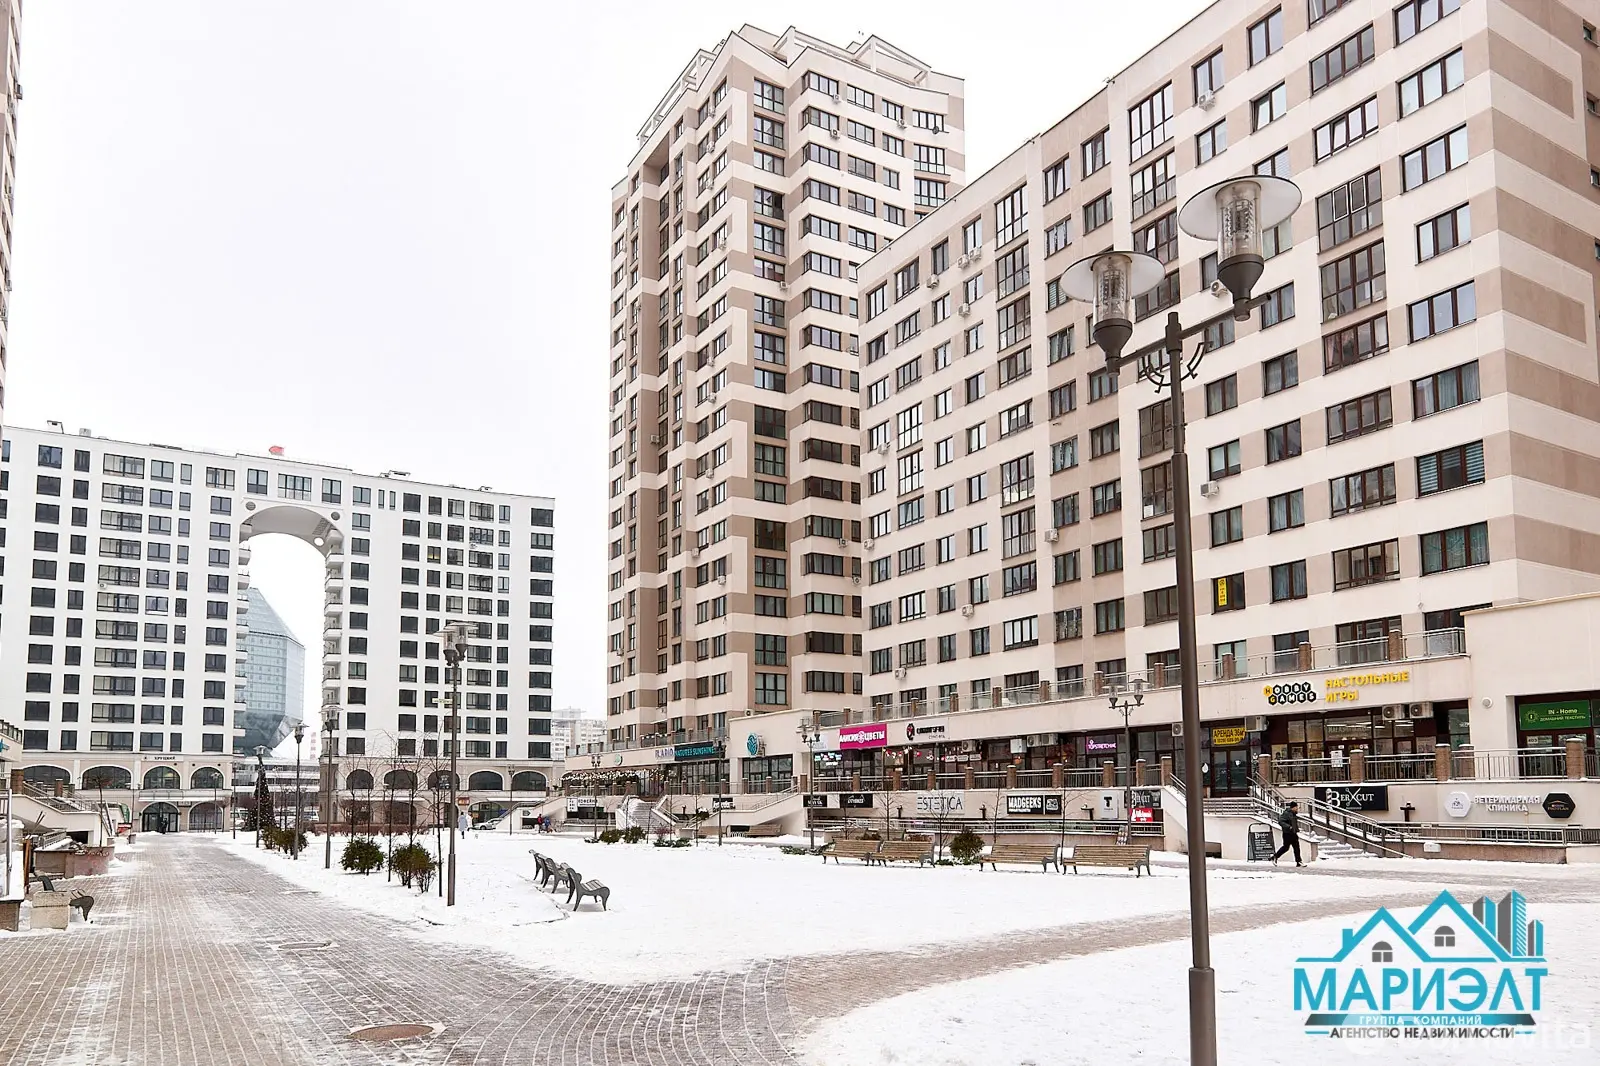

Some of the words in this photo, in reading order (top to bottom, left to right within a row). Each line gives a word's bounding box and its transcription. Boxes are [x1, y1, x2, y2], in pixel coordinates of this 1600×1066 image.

[1325, 670, 1410, 688] НАСТОЛЬНЫЕ
[1264, 682, 1312, 696] HOBBY
[1268, 691, 1317, 705] GAMES
[1325, 690, 1360, 703] ИГРЫ
[864, 731, 885, 741] ЦВЕТЫ
[1213, 729, 1233, 738] АРЕНДА
[1008, 796, 1042, 808] MADGEEKS
[1474, 795, 1541, 804] ВЕТЕРИНАРНАЯ
[1486, 804, 1529, 812] КЛИНИКА
